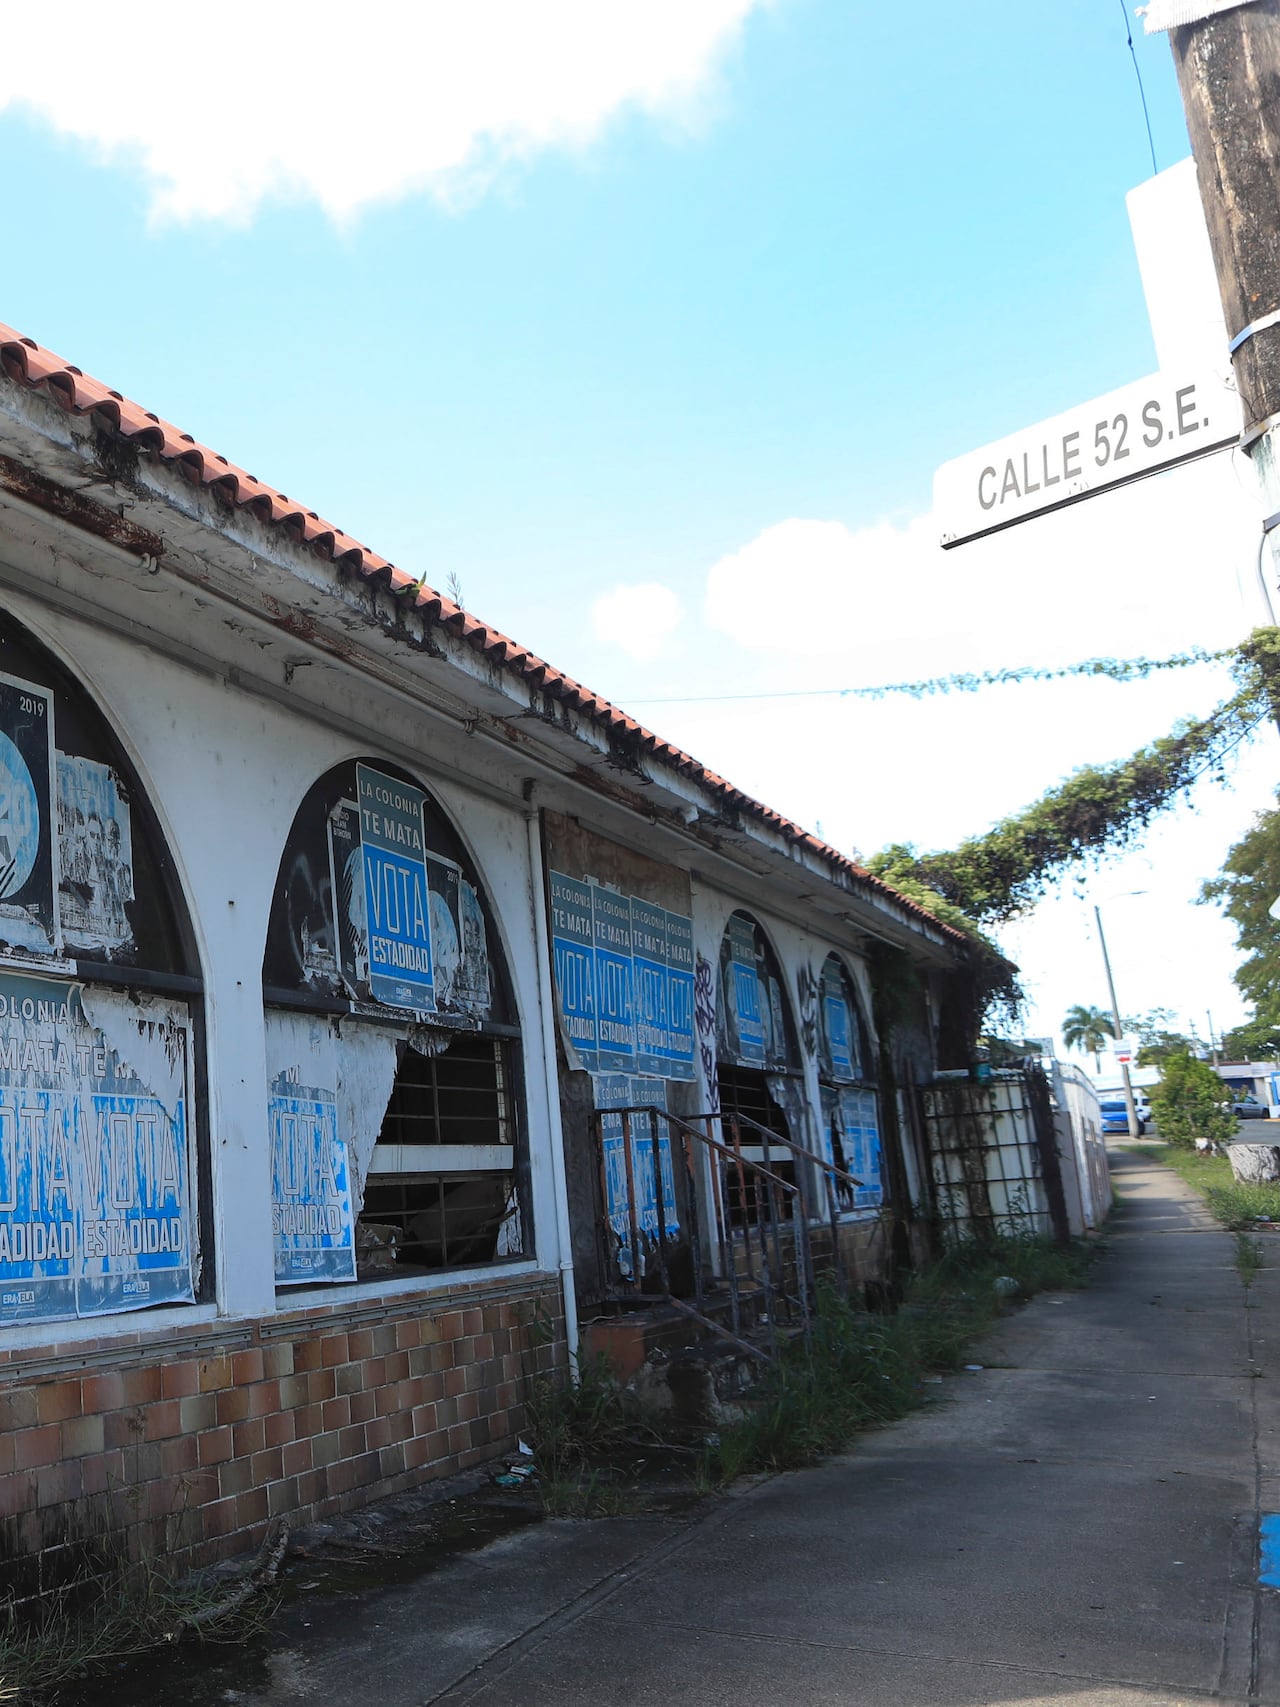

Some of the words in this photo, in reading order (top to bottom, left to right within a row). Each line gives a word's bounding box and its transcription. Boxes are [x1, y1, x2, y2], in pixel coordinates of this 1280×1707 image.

[977, 431, 1082, 511] CALLE
[1094, 413, 1130, 467] 52
[1141, 384, 1210, 448] S.E.
[19, 695, 45, 719] 2019
[360, 780, 373, 799] LA
[375, 786, 419, 818] COLONIA
[362, 808, 381, 836] TE
[384, 817, 421, 851] MATA
[367, 856, 427, 942] VOTA
[551, 883, 561, 898] LA
[562, 887, 591, 910] COLONIA
[594, 897, 603, 912] LA
[604, 901, 630, 920] COLONIA
[553, 908, 565, 929] TE
[567, 913, 592, 937] MATA
[632, 907, 640, 921] LA
[595, 920, 606, 939] TE
[608, 925, 630, 948] MATA
[633, 930, 643, 948] TE
[372, 935, 429, 974] ESTADIDAD
[671, 943, 692, 964] MATA
[555, 948, 594, 1014] VOTA
[597, 957, 633, 1020] VOTA
[634, 964, 667, 1025] VOTA
[600, 1019, 632, 1046] ESTADIDAD
[76, 1044, 107, 1079] TE
[602, 1086, 629, 1101] COLONIA
[633, 1090, 640, 1103] LA
[80, 1110, 181, 1210] VOTA
[272, 1203, 341, 1236] STADIDAD
[81, 1216, 184, 1260] ESTADIDAD
